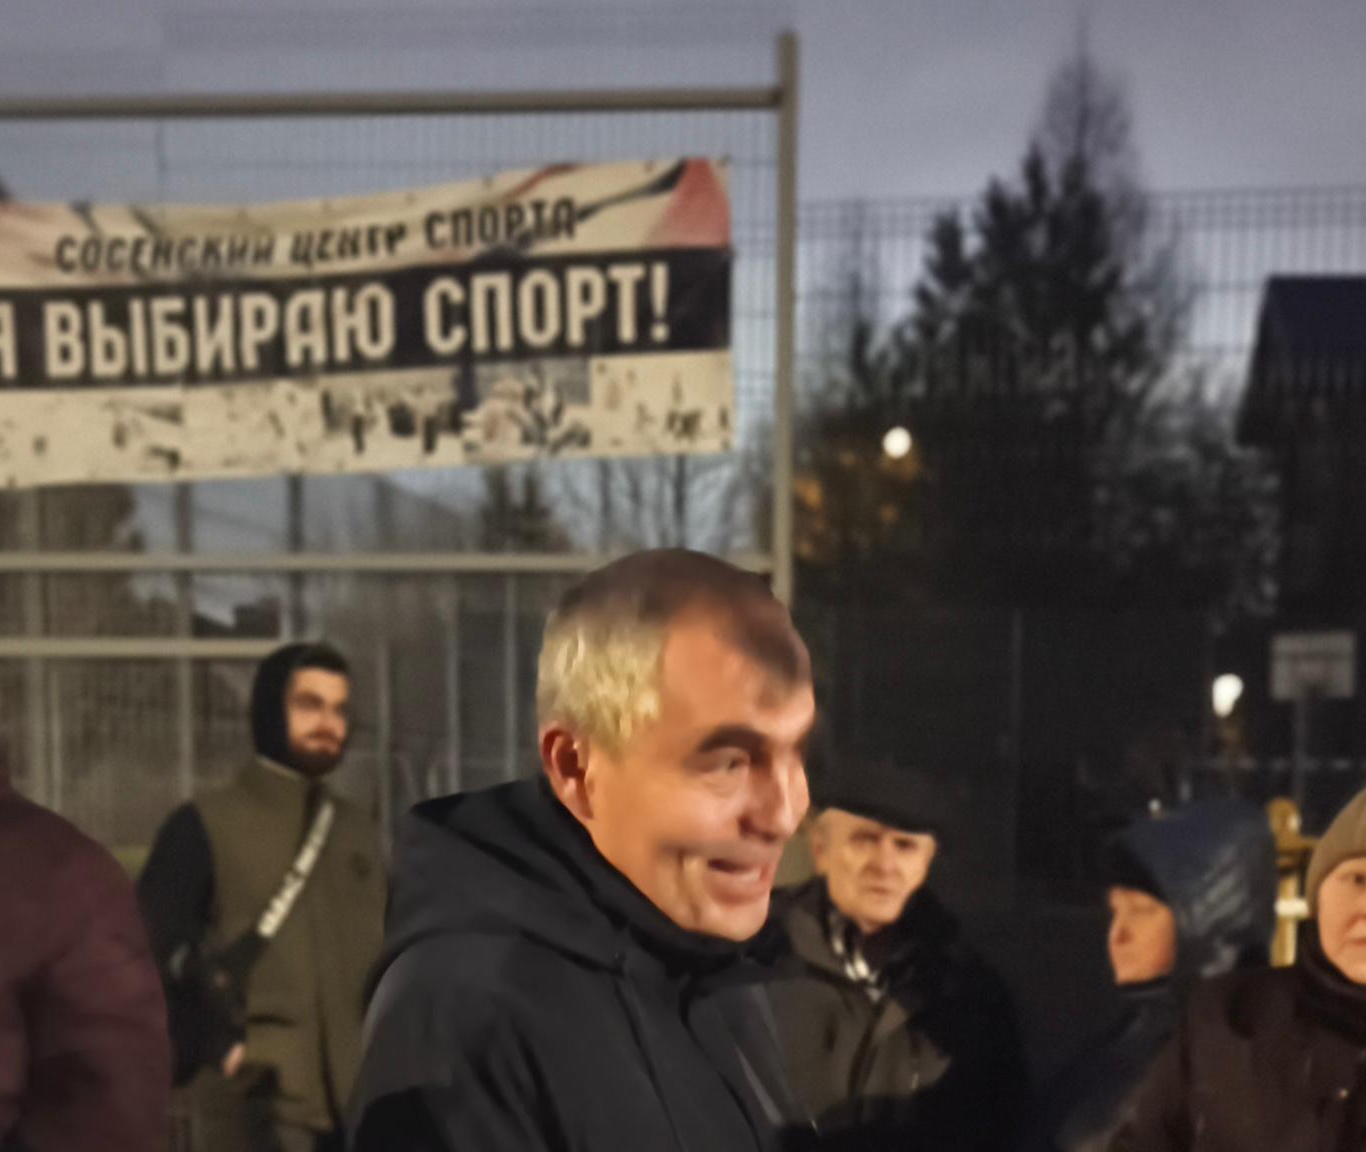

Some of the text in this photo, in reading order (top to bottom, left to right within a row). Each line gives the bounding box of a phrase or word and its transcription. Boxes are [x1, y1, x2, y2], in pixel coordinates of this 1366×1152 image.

[424, 197, 577, 250] СПОРТА
[43, 283, 395, 380] ВЫБИРАЮ
[422, 262, 671, 356] СПОРТ!
